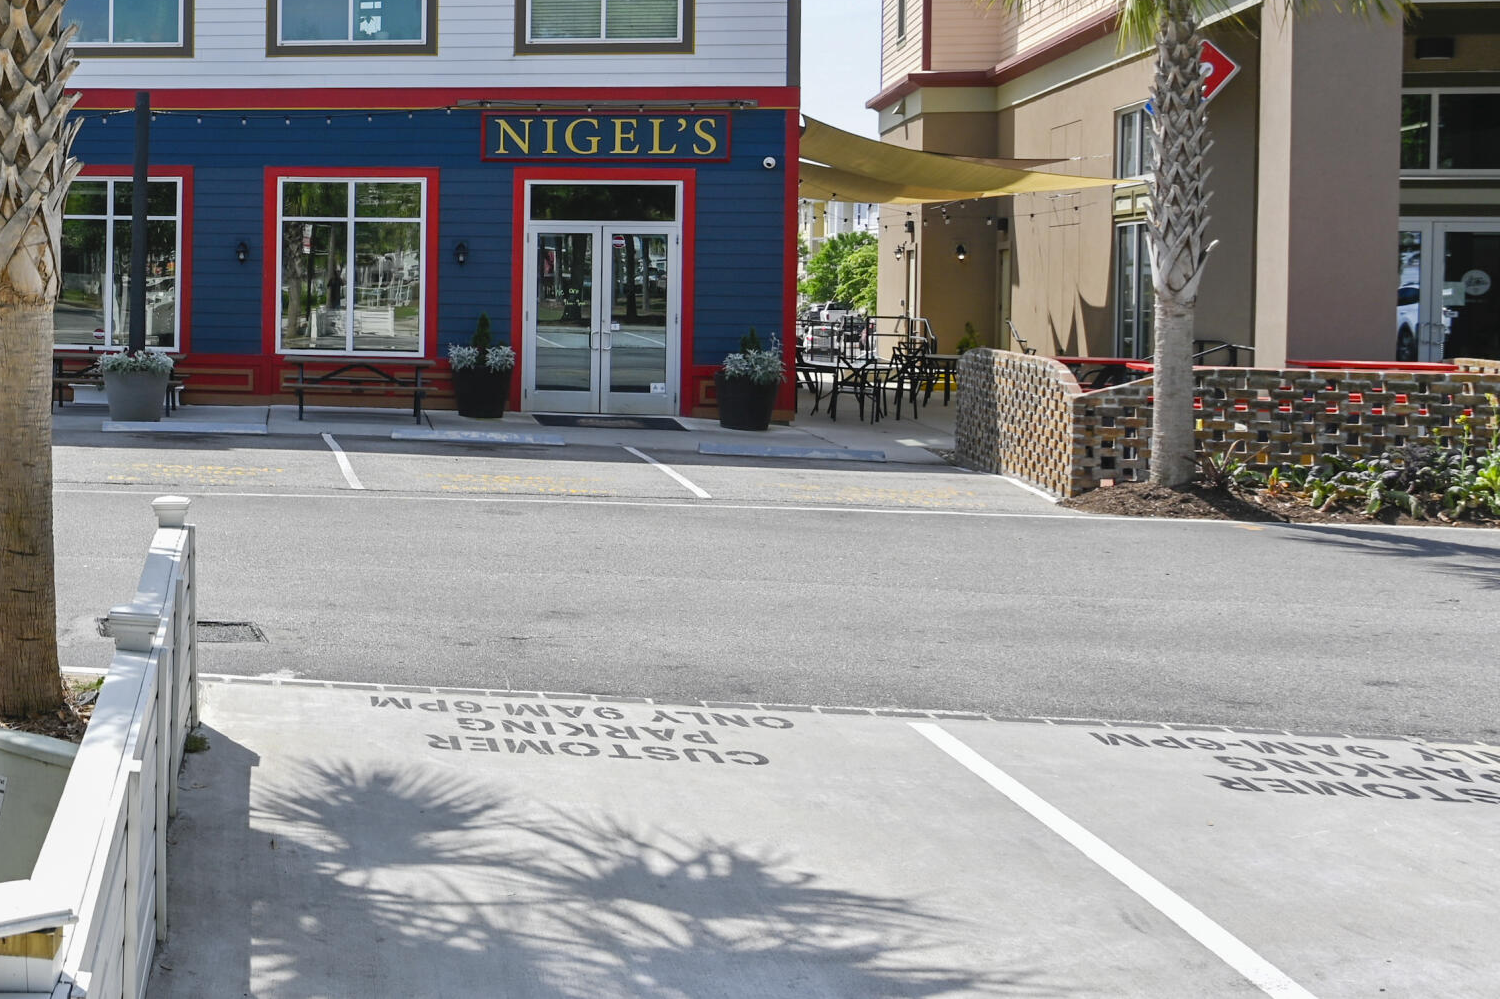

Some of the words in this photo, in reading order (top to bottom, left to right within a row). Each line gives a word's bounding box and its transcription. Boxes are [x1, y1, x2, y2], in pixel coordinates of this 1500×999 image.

[494, 118, 717, 155] NIGEL'S
[370, 696, 624, 720] 9AM-6PM
[651, 710, 794, 729] ONLY
[456, 718, 718, 744] PARKING
[425, 734, 770, 765] CUSTOMER
[1088, 732, 1389, 759] 9AM-6PM
